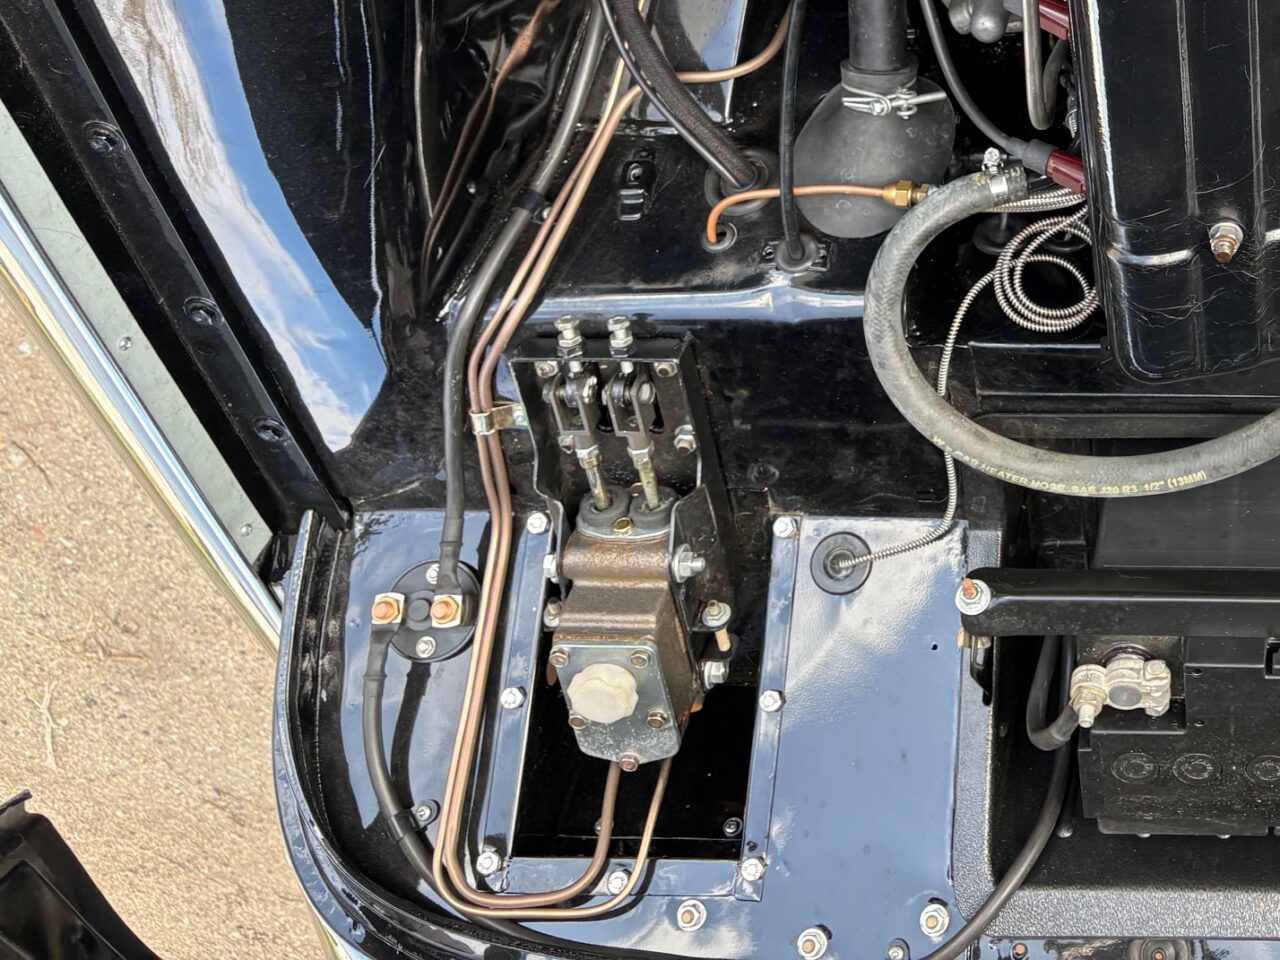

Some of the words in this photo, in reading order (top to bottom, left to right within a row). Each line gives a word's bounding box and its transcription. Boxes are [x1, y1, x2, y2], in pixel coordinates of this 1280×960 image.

[980, 464, 1028, 483] HEATER
[1030, 480, 1066, 491] HOSE
[1072, 485, 1096, 494] SAE
[1122, 484, 1138, 494] R3
[1143, 481, 1164, 492] 1/2"
[1168, 470, 1208, 490] (13MM)
